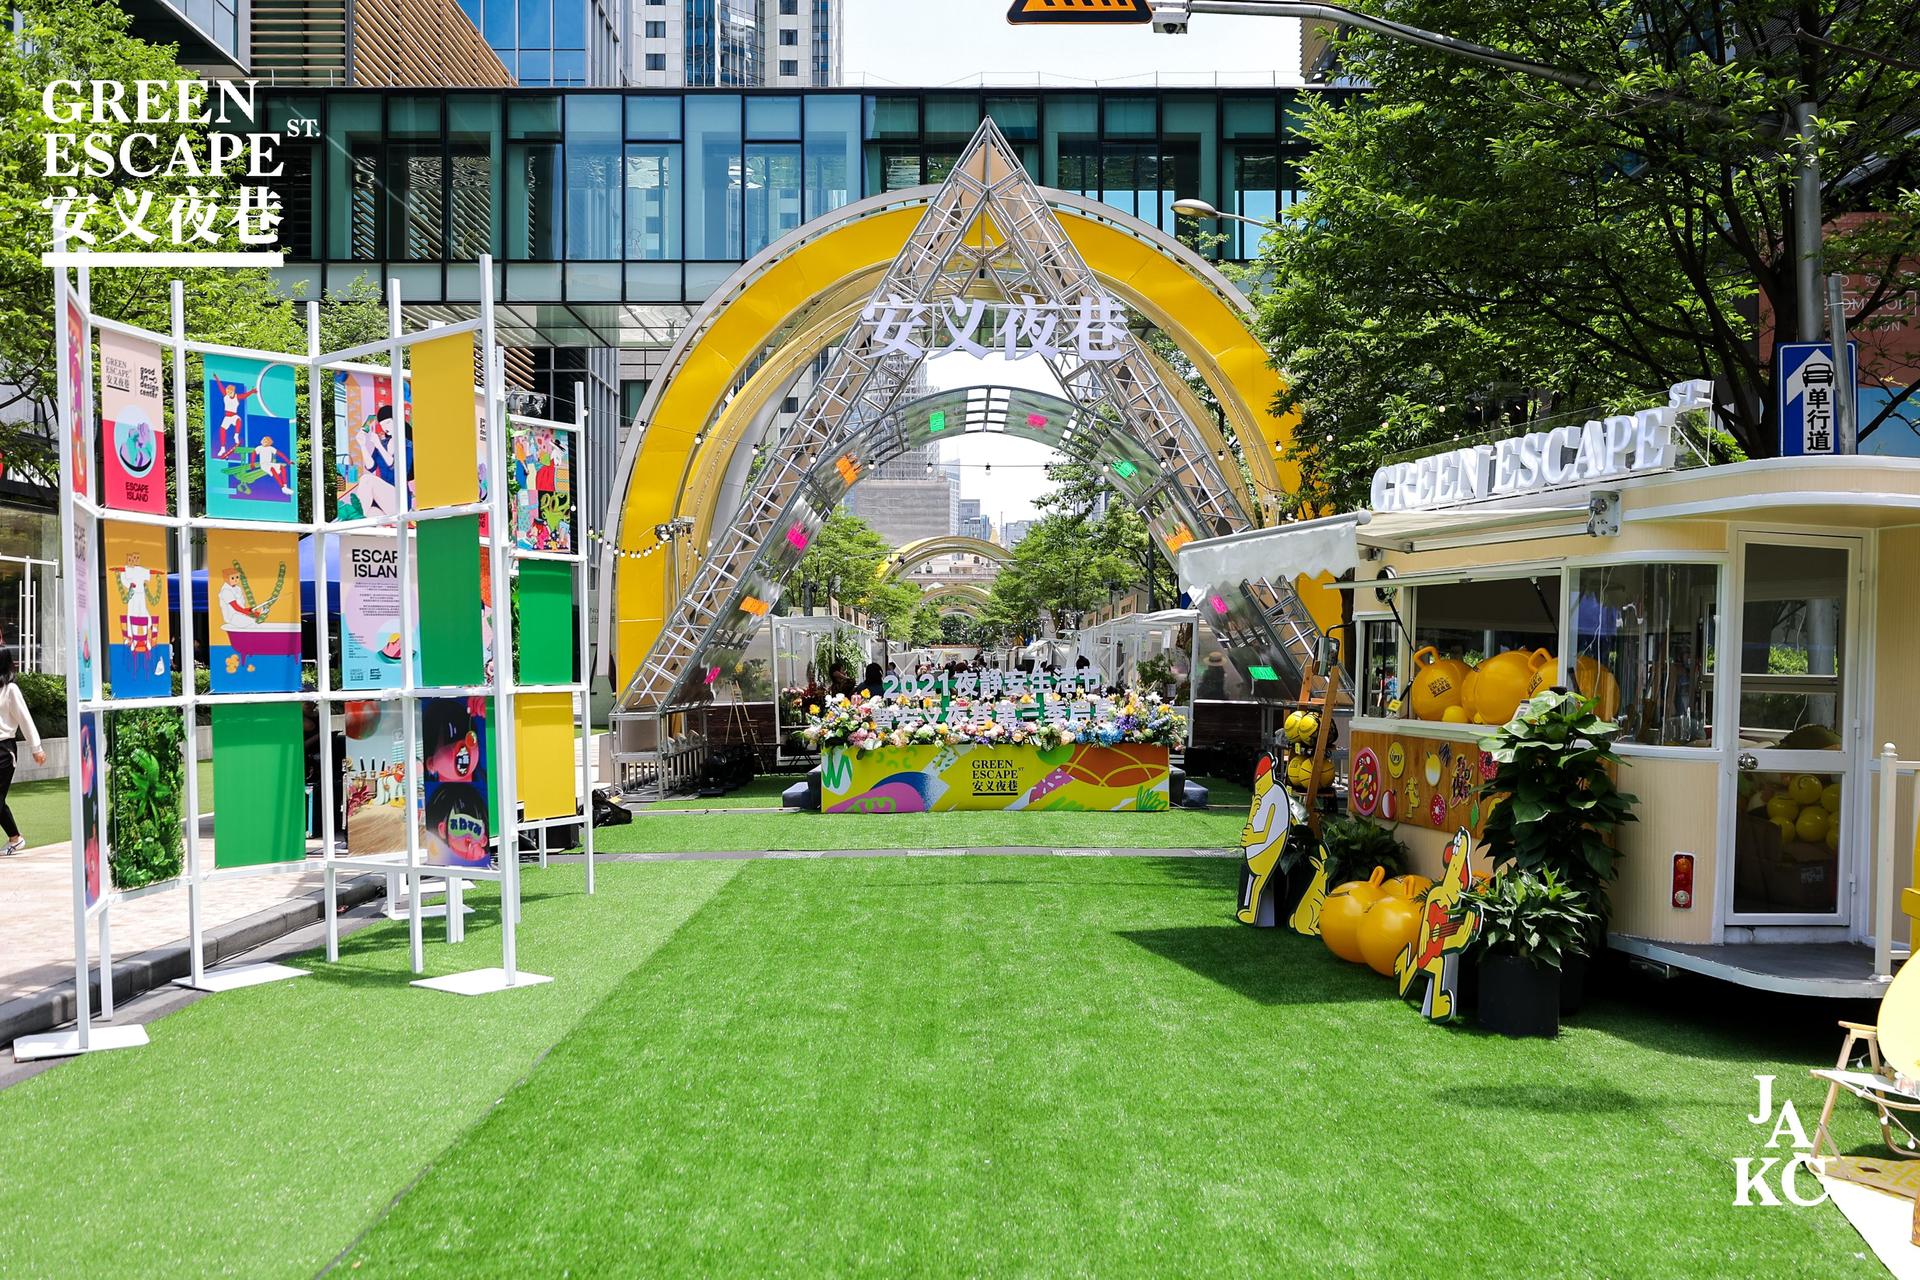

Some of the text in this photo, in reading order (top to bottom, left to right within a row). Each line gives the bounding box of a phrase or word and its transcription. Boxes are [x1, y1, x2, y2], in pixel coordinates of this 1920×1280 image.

[860, 294, 1129, 360] 安义夜巷
[1806, 388, 1831, 452] 单行道
[1371, 444, 1494, 511] GREEN
[1492, 406, 1676, 494] ESCAPE
[125, 481, 149, 494] ESCAPE
[126, 491, 149, 503] ISLAND
[352, 549, 398, 563] ESCAP
[354, 564, 398, 578] ISLAN
[972, 760, 1013, 769] GREEN
[972, 770, 1018, 779] ESCAPE
[972, 780, 1018, 792] 安义夜巷
